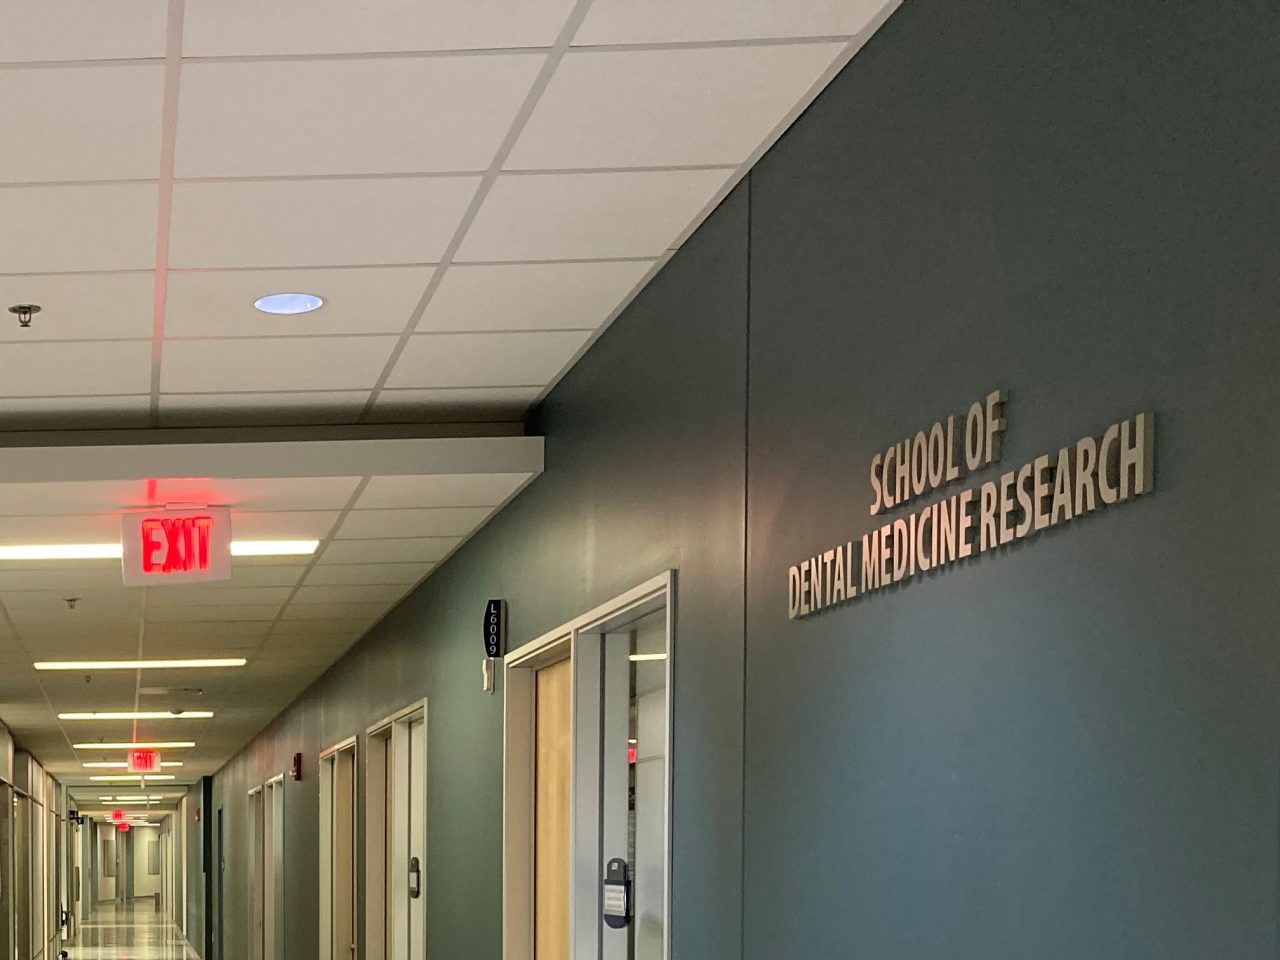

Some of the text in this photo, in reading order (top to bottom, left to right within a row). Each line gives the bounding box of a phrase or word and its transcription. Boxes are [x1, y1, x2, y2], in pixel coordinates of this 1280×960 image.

[869, 389, 1007, 516] SCHOOL OF
[141, 516, 213, 574] EXIT
[788, 412, 1152, 620] DENTAL MEDICINE RESEARCH
[489, 603, 498, 655] L6009
[132, 750, 157, 770] EXIT
